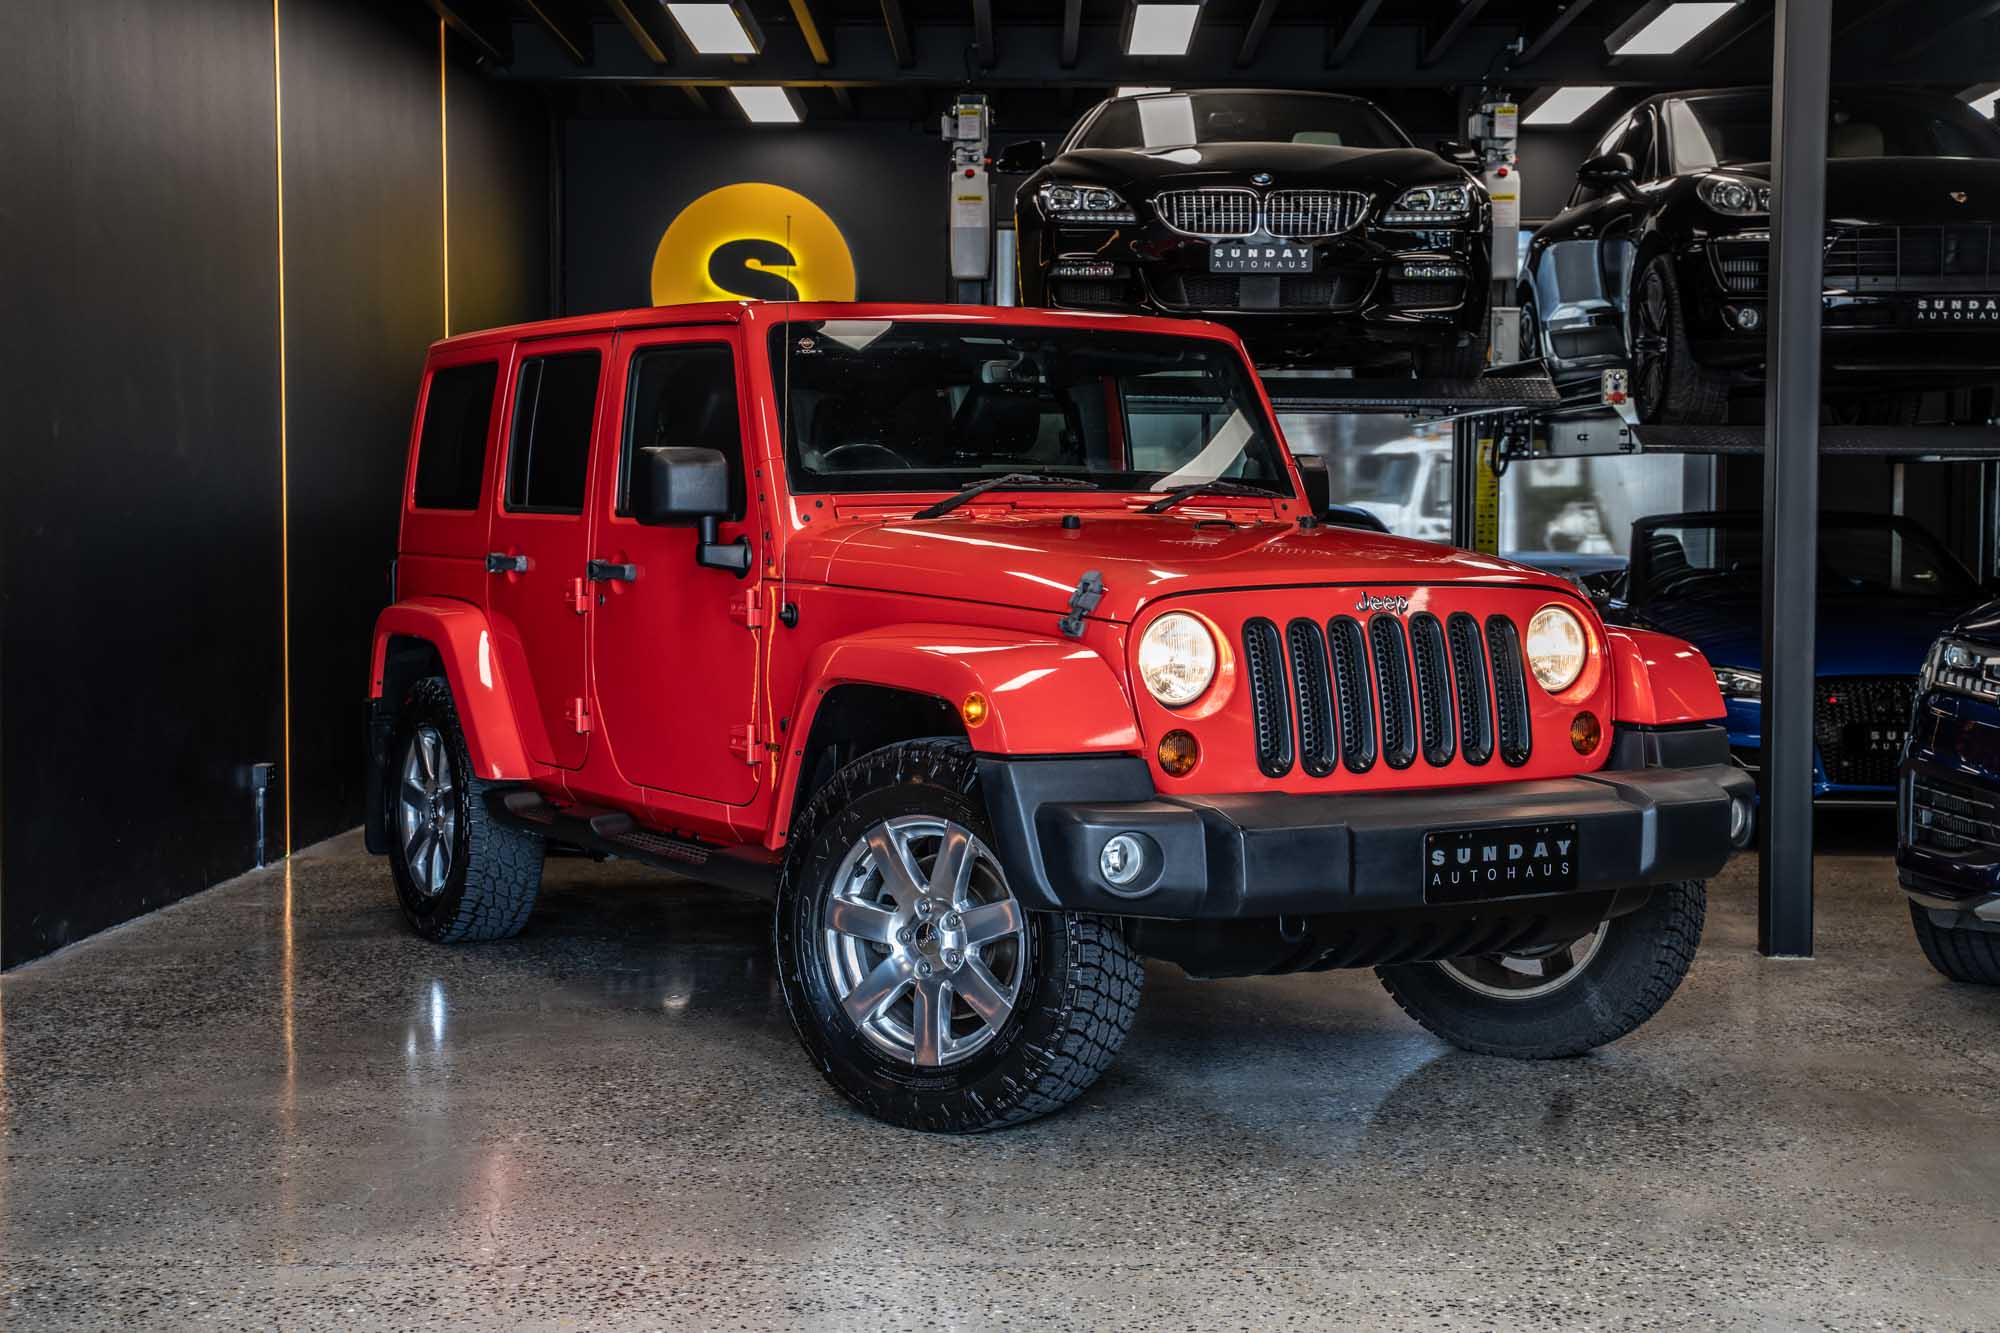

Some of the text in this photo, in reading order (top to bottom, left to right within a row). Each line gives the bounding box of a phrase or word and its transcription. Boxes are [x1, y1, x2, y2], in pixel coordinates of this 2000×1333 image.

[1214, 248, 1308, 258] SUNDAY
[1214, 261, 1308, 269] AUTOHAUS
[1917, 299, 1997, 310] SUNDA
[1917, 311, 1999, 320] AUTOHAU
[1355, 591, 1409, 616] Jeep
[1431, 840, 1571, 866] SUNDAY
[1432, 862, 1570, 886] AUTOHAUS
